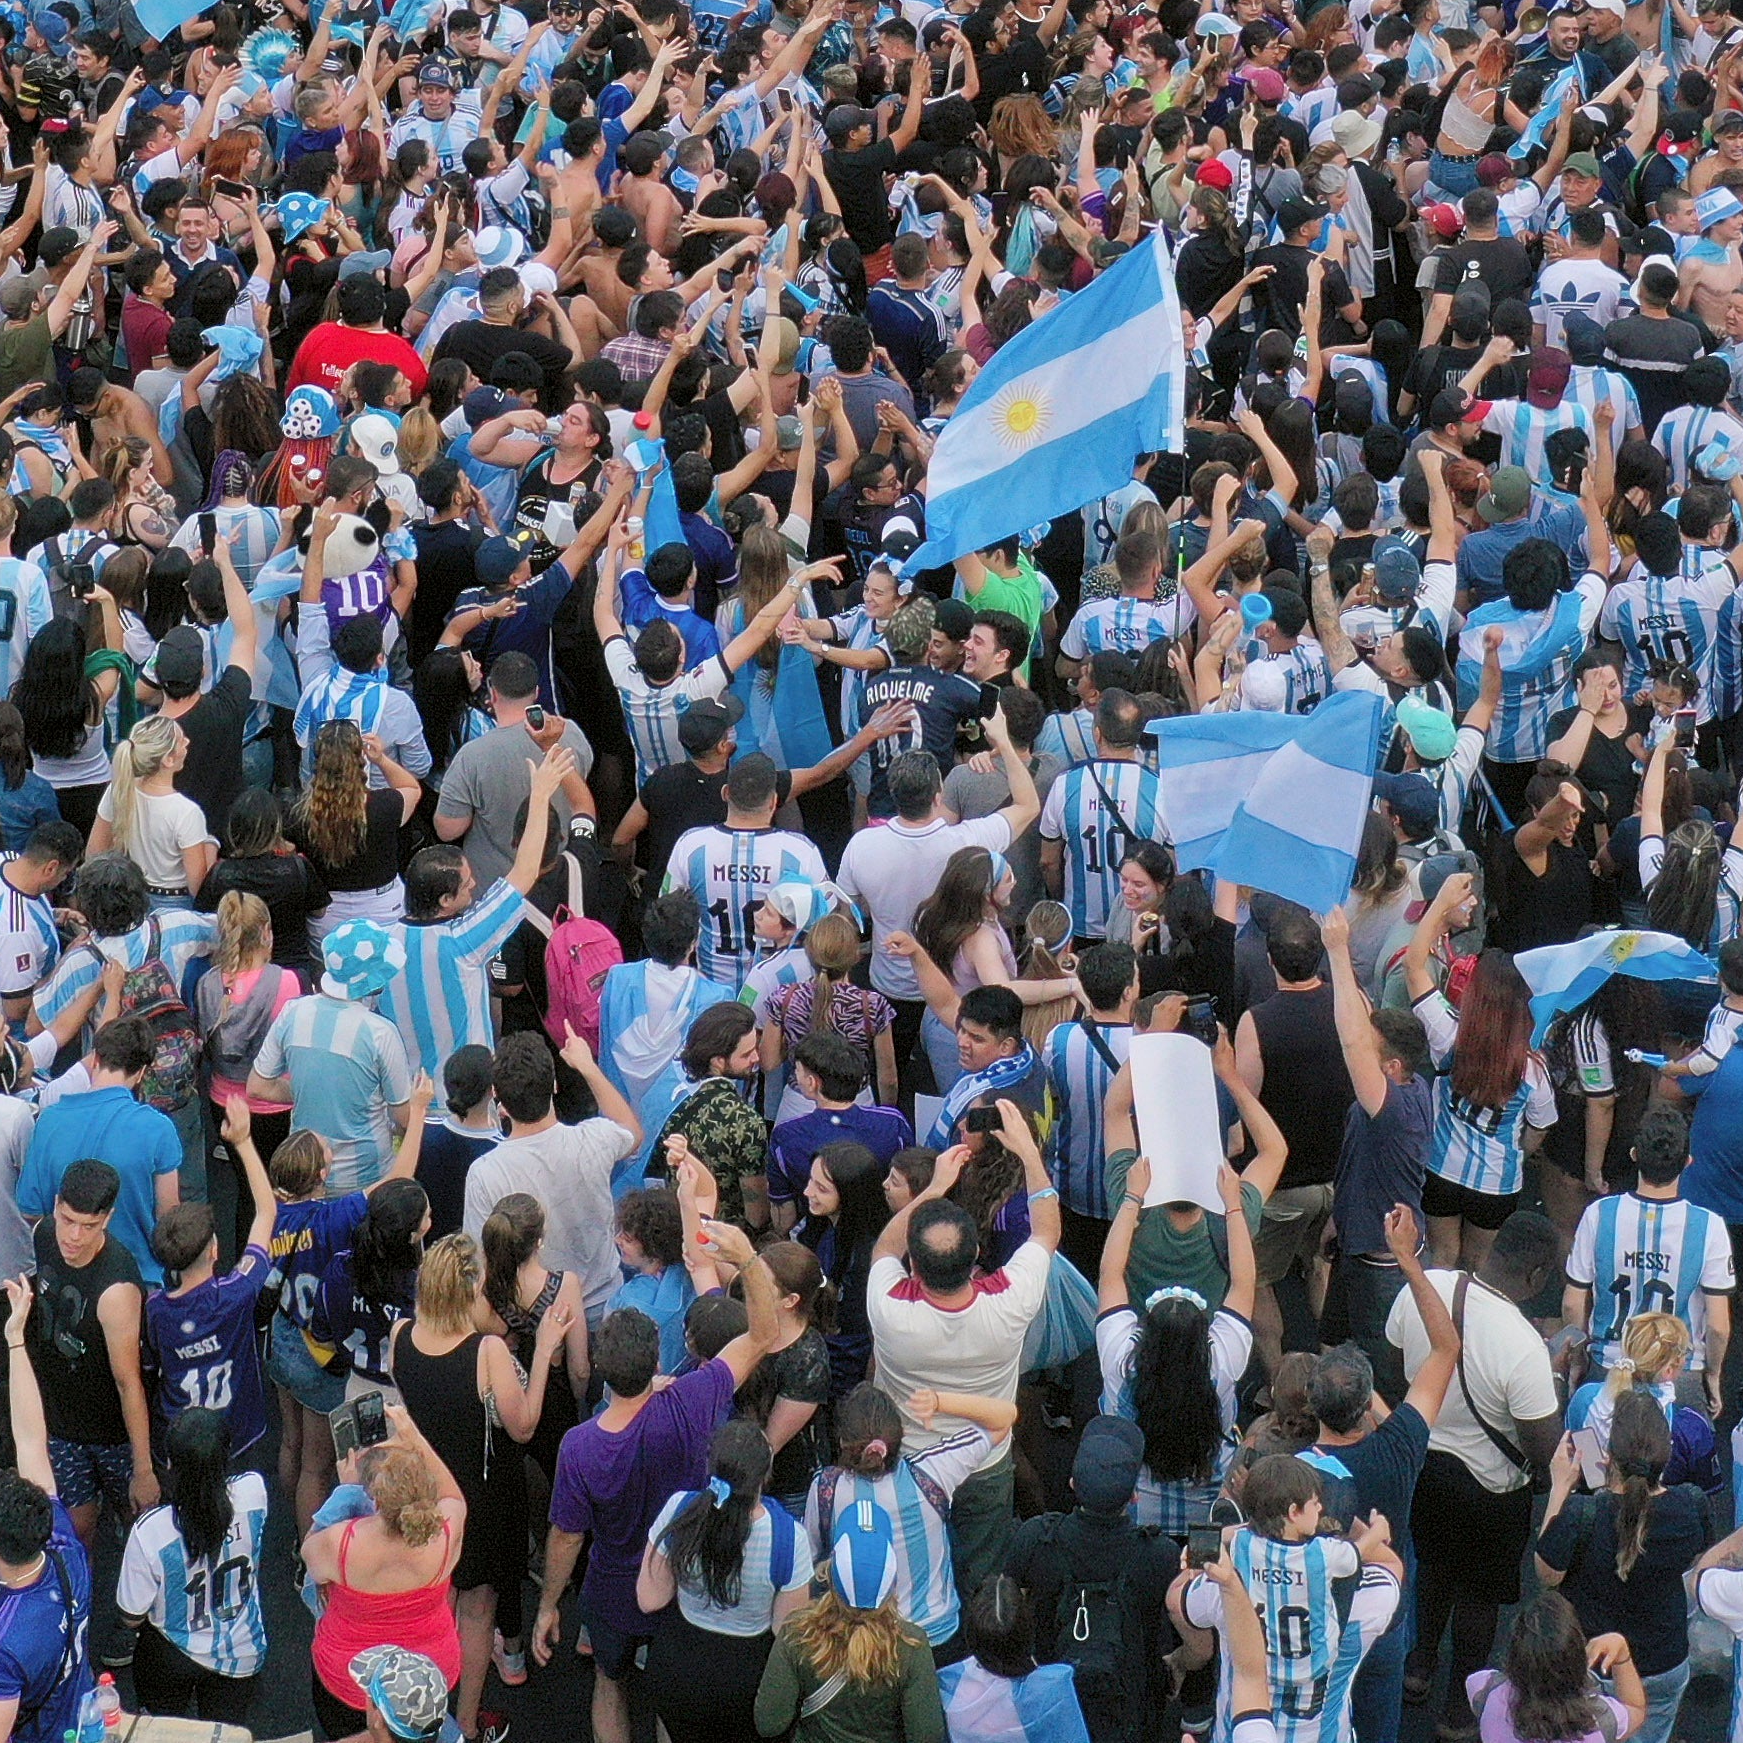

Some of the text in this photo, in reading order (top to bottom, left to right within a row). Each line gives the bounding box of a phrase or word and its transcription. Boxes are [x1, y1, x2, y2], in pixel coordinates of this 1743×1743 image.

[331, 570, 384, 617] 10
[1105, 627, 1142, 642] MESSI
[1638, 614, 1677, 631] MESSI
[866, 681, 935, 706] RIQUELME
[712, 864, 771, 885] MESSI
[1624, 1250, 1671, 1273] MESSI
[177, 1333, 223, 1360] MESSI
[179, 1359, 234, 1411] 10
[1250, 1566, 1305, 1590] MESSI
[183, 1555, 252, 1630] 10
